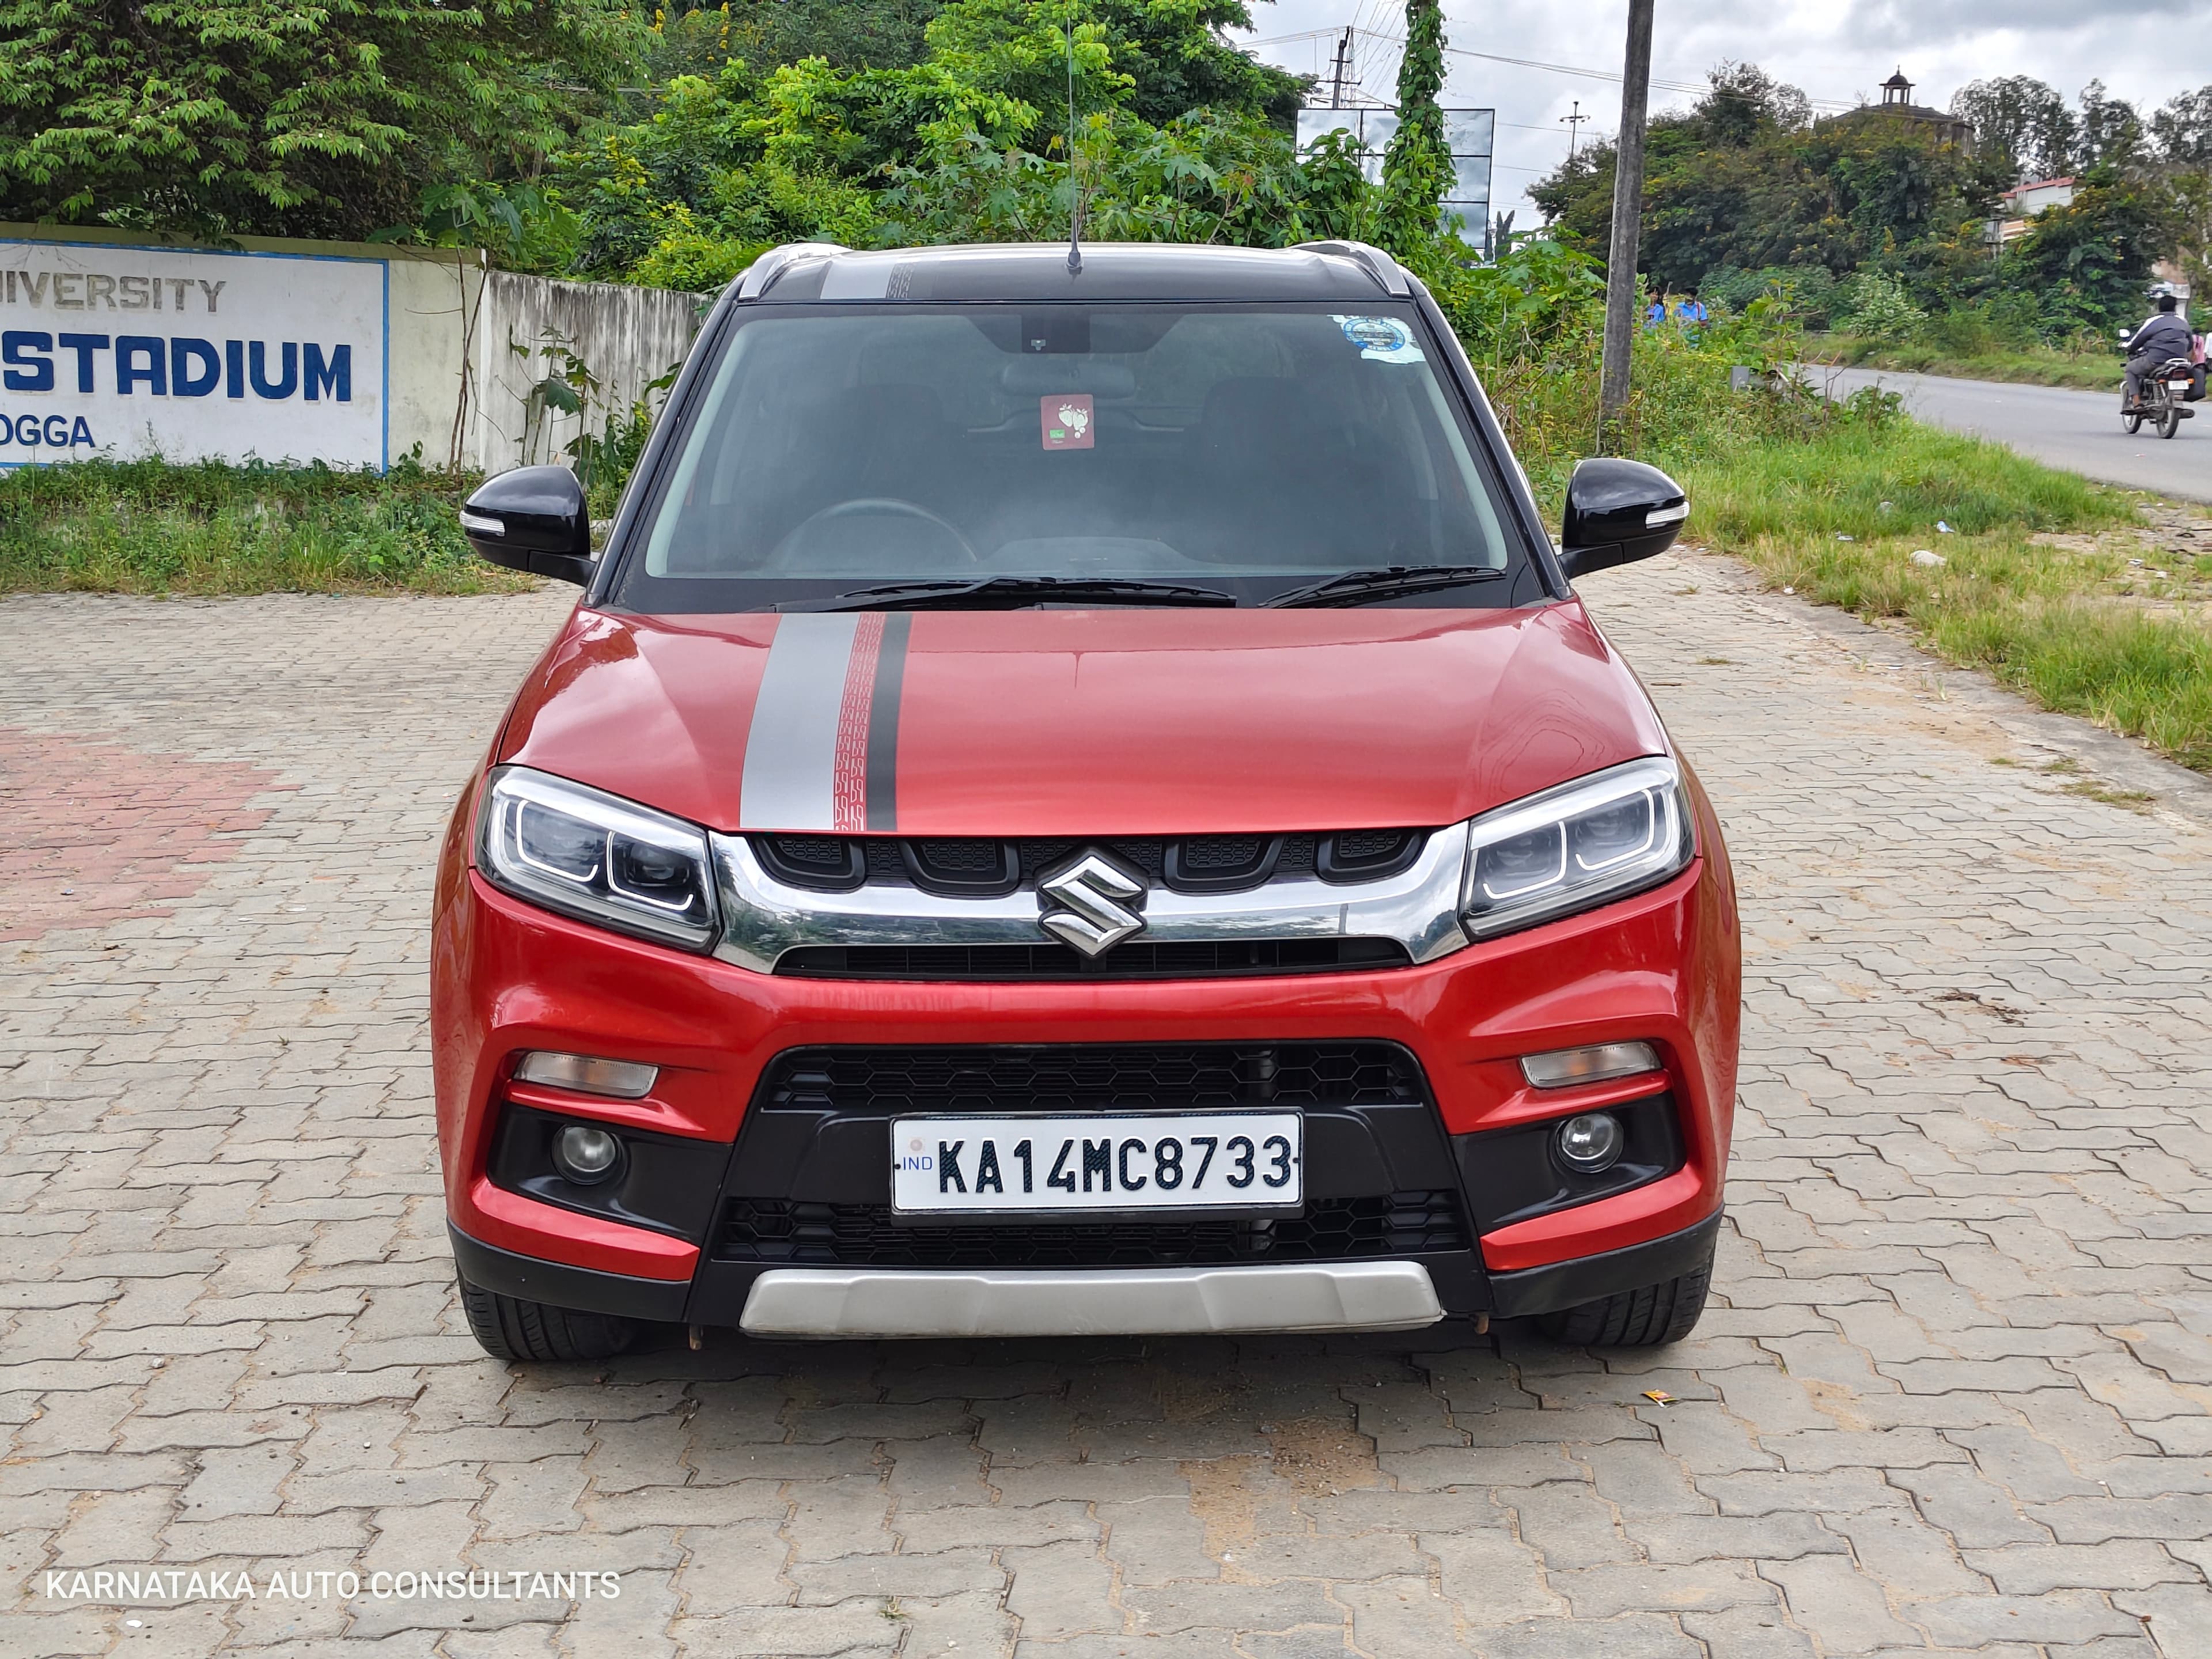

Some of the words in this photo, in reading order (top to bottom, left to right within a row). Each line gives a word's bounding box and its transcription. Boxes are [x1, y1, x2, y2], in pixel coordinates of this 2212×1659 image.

[0, 270, 226, 312] IVERSITY
[2, 331, 351, 402] STADIUM
[903, 1156, 933, 1170] IND
[938, 1135, 1291, 1193] KA14MC8733
